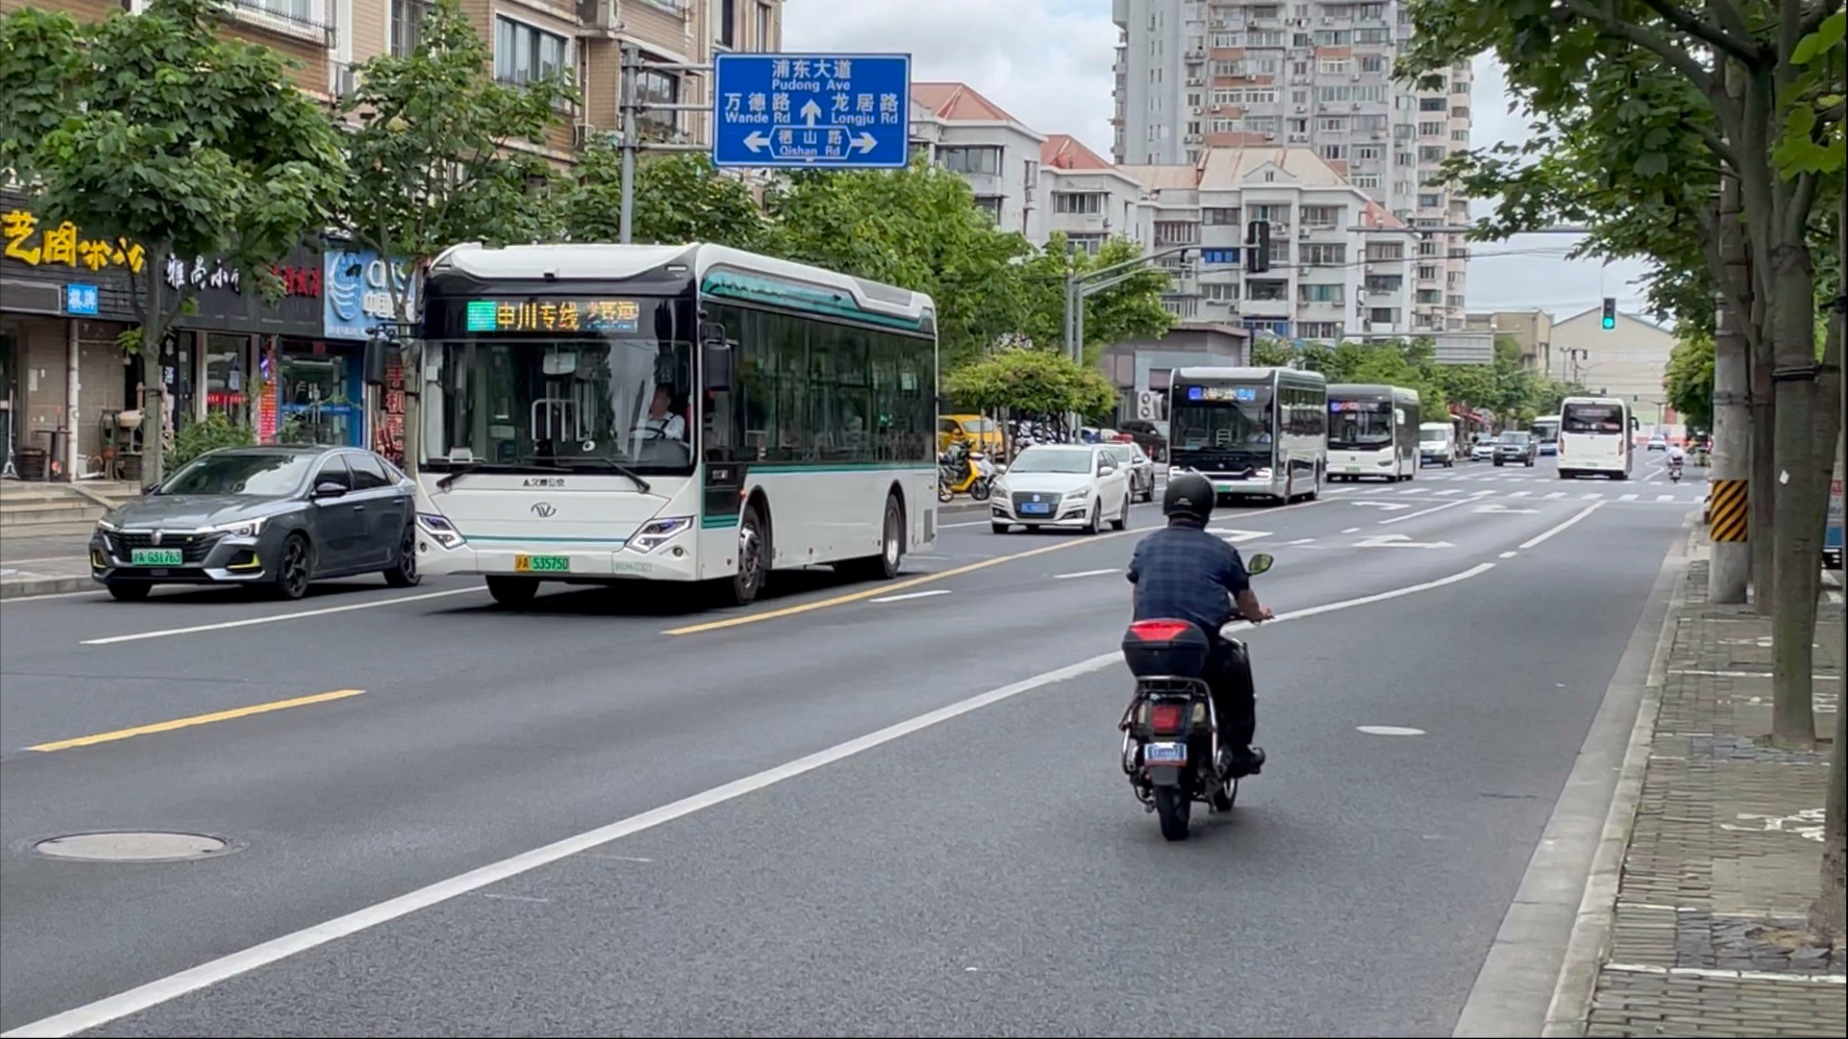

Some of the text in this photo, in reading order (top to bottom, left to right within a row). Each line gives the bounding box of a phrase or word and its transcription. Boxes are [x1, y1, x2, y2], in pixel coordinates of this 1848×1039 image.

[772, 59, 852, 79] 浦东大道
[772, 79, 851, 93] Pudong Ave
[724, 93, 791, 112] 万德路
[831, 93, 899, 112] 龙居路
[725, 112, 791, 124] Wande Rd
[831, 112, 898, 126] Longju Rd
[778, 130, 843, 145] 栖山路
[780, 145, 841, 157] Qishan Rd
[497, 301, 580, 331] 申川专线
